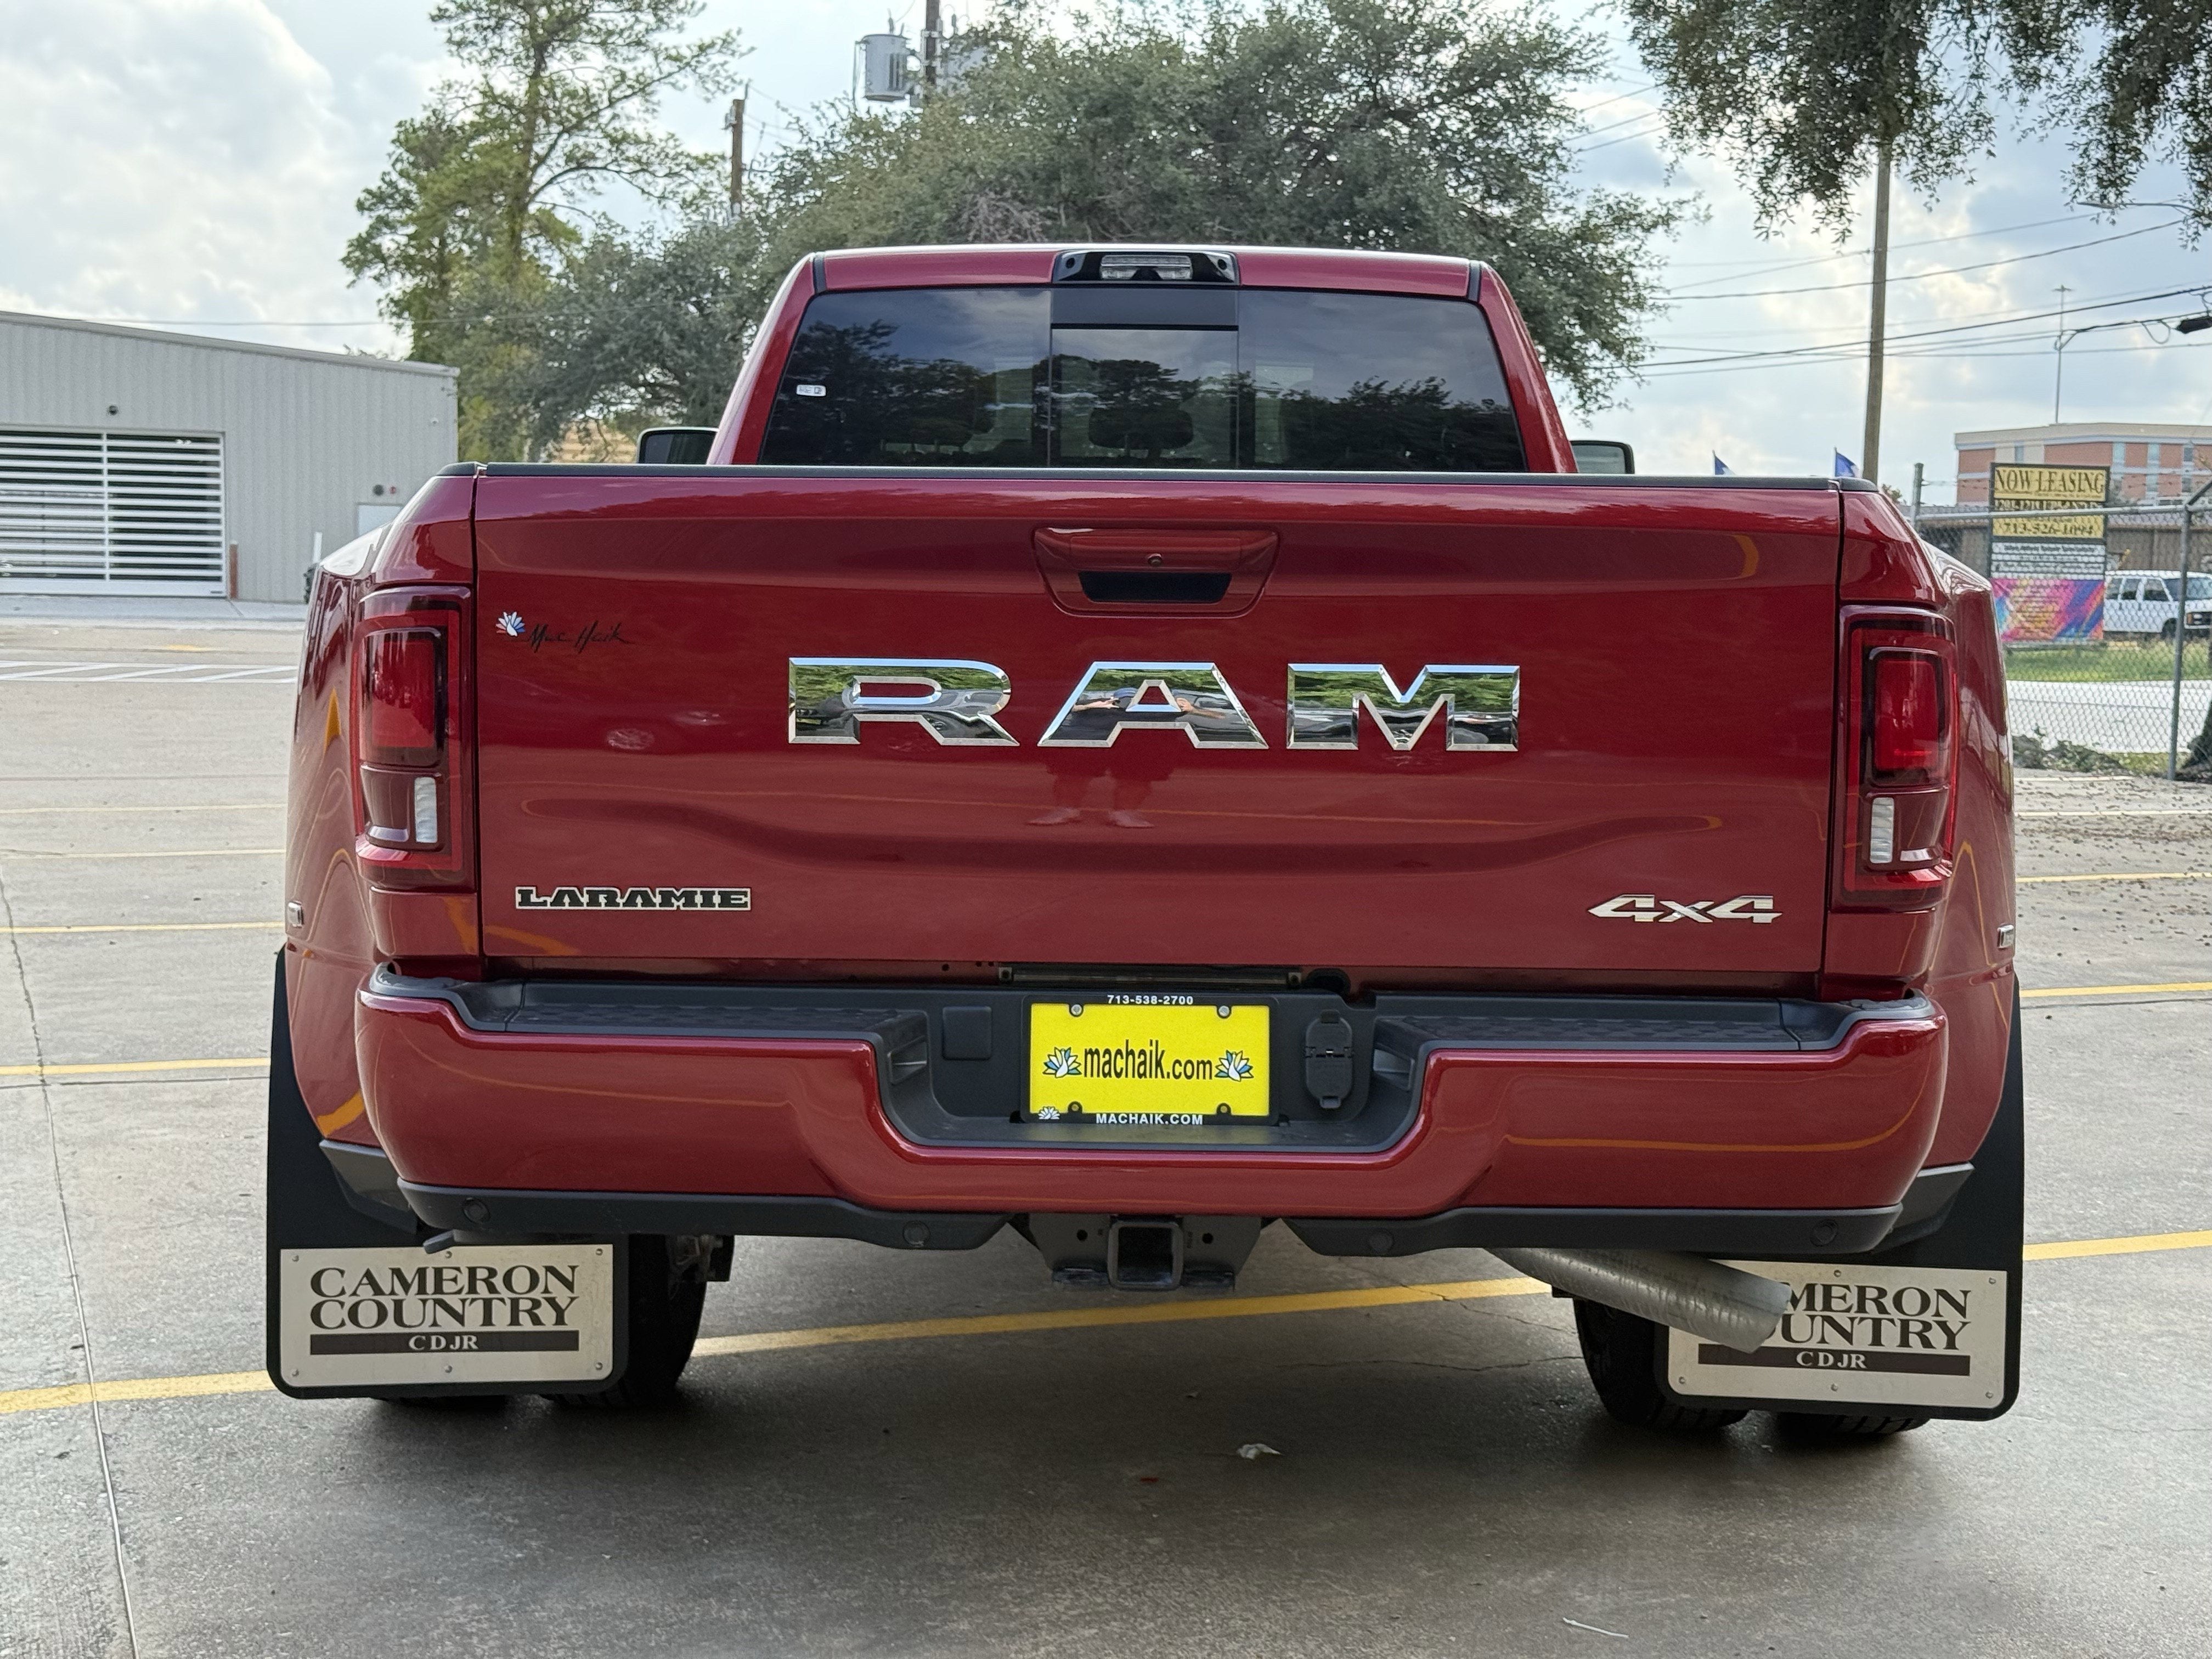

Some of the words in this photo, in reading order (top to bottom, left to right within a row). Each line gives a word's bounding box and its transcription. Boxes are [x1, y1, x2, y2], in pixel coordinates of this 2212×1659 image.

[1995, 469, 2031, 490] NOW
[2036, 471, 2104, 494] LEASING
[788, 657, 1521, 751] RAM
[516, 886, 752, 911] LARAMIE
[1588, 894, 1784, 923] 4x4
[1107, 995, 1194, 1005] 713-538-2700
[1084, 1039, 1213, 1080] machaik.com
[1096, 1113, 1203, 1125] MACHAIK.COM
[310, 1265, 580, 1298] CAMERON
[310, 1296, 580, 1330] COUNTRY
[1779, 1282, 1972, 1319] MERON
[408, 1335, 479, 1351] CDJR
[1765, 1313, 1972, 1351] UNTRY
[1796, 1350, 1867, 1369] CDJR
